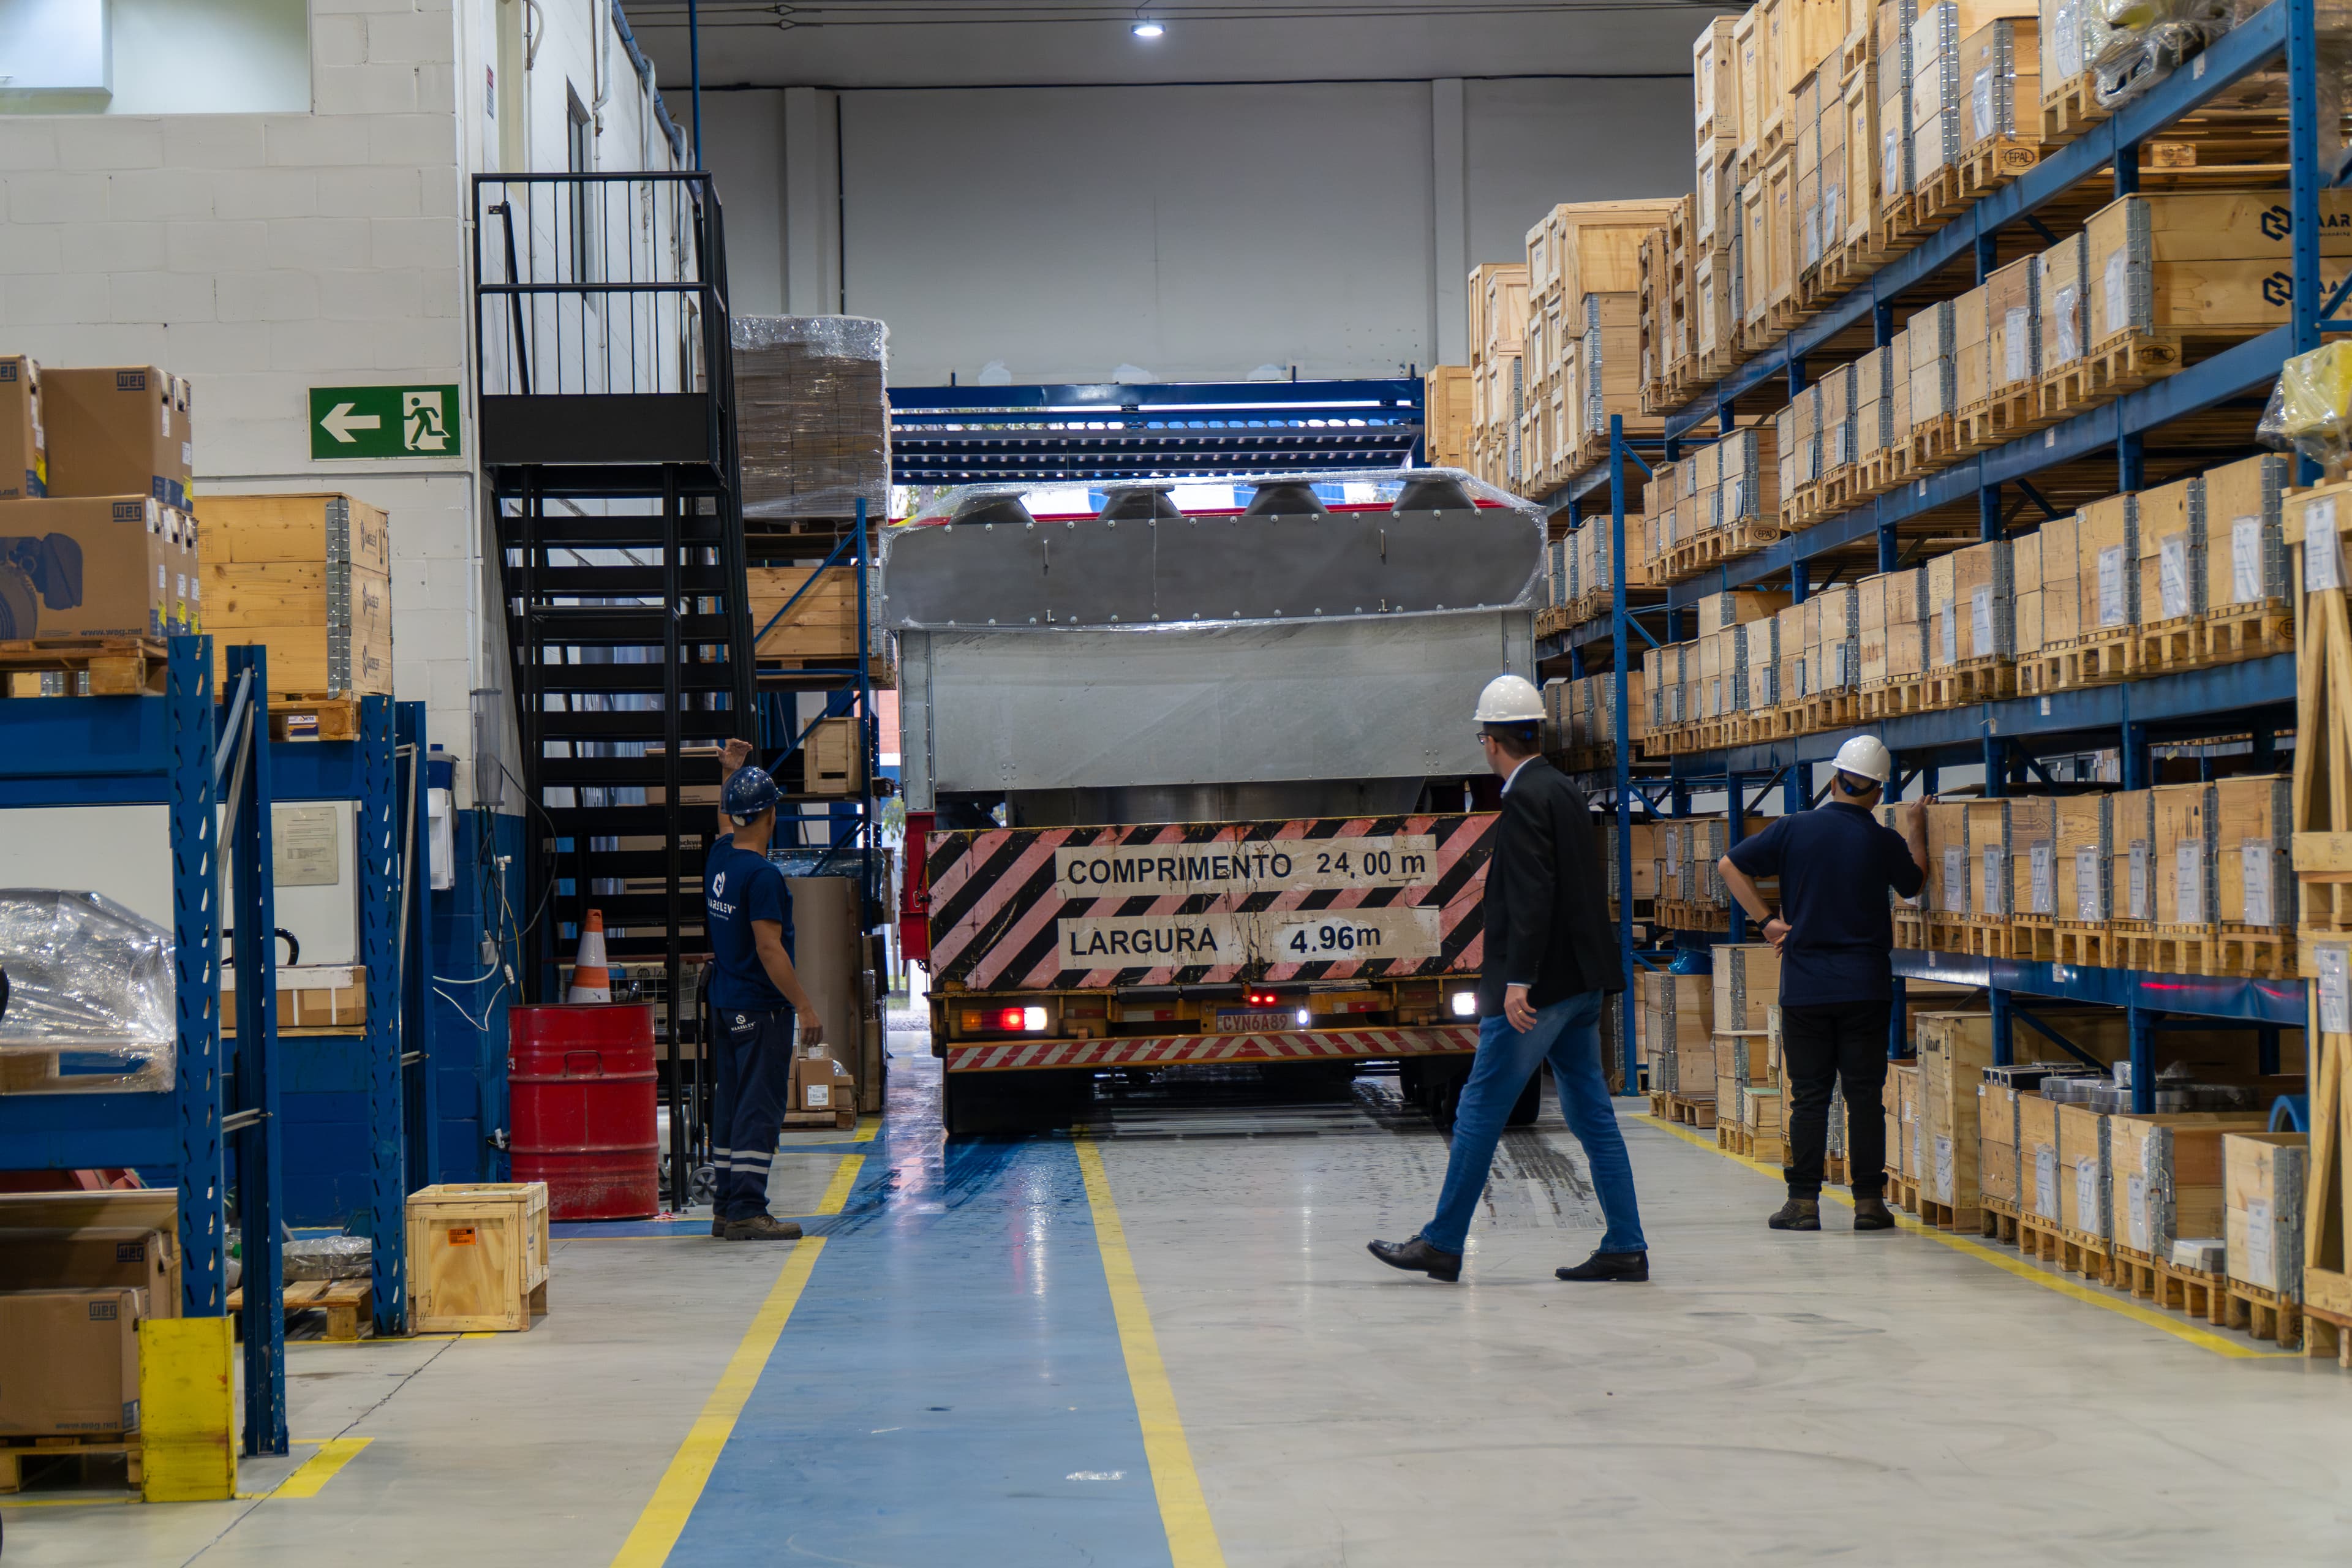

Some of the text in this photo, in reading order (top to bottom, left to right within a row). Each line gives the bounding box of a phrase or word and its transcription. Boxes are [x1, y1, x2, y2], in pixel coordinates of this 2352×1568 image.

[1068, 853, 1292, 884] COMPRIMENTO
[1401, 854, 1426, 873] m
[1071, 927, 1219, 956] LARGURA
[1223, 1014, 1287, 1031] CYN6A89
